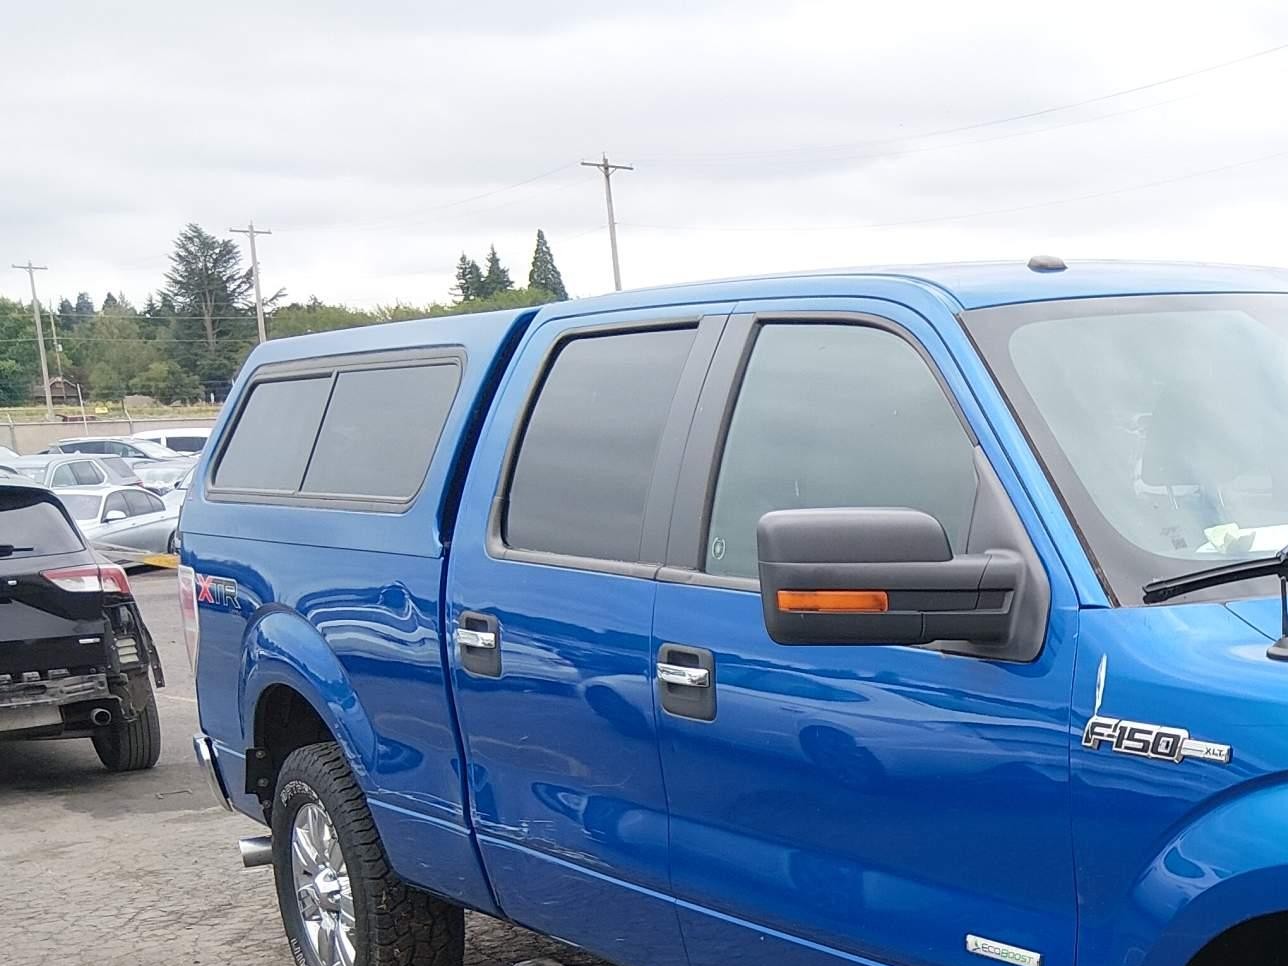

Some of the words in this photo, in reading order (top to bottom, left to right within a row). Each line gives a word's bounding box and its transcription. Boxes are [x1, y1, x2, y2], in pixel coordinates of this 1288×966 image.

[195, 573, 241, 609] XTR
[1082, 716, 1188, 763] F-150
[1204, 746, 1225, 758] XLT
